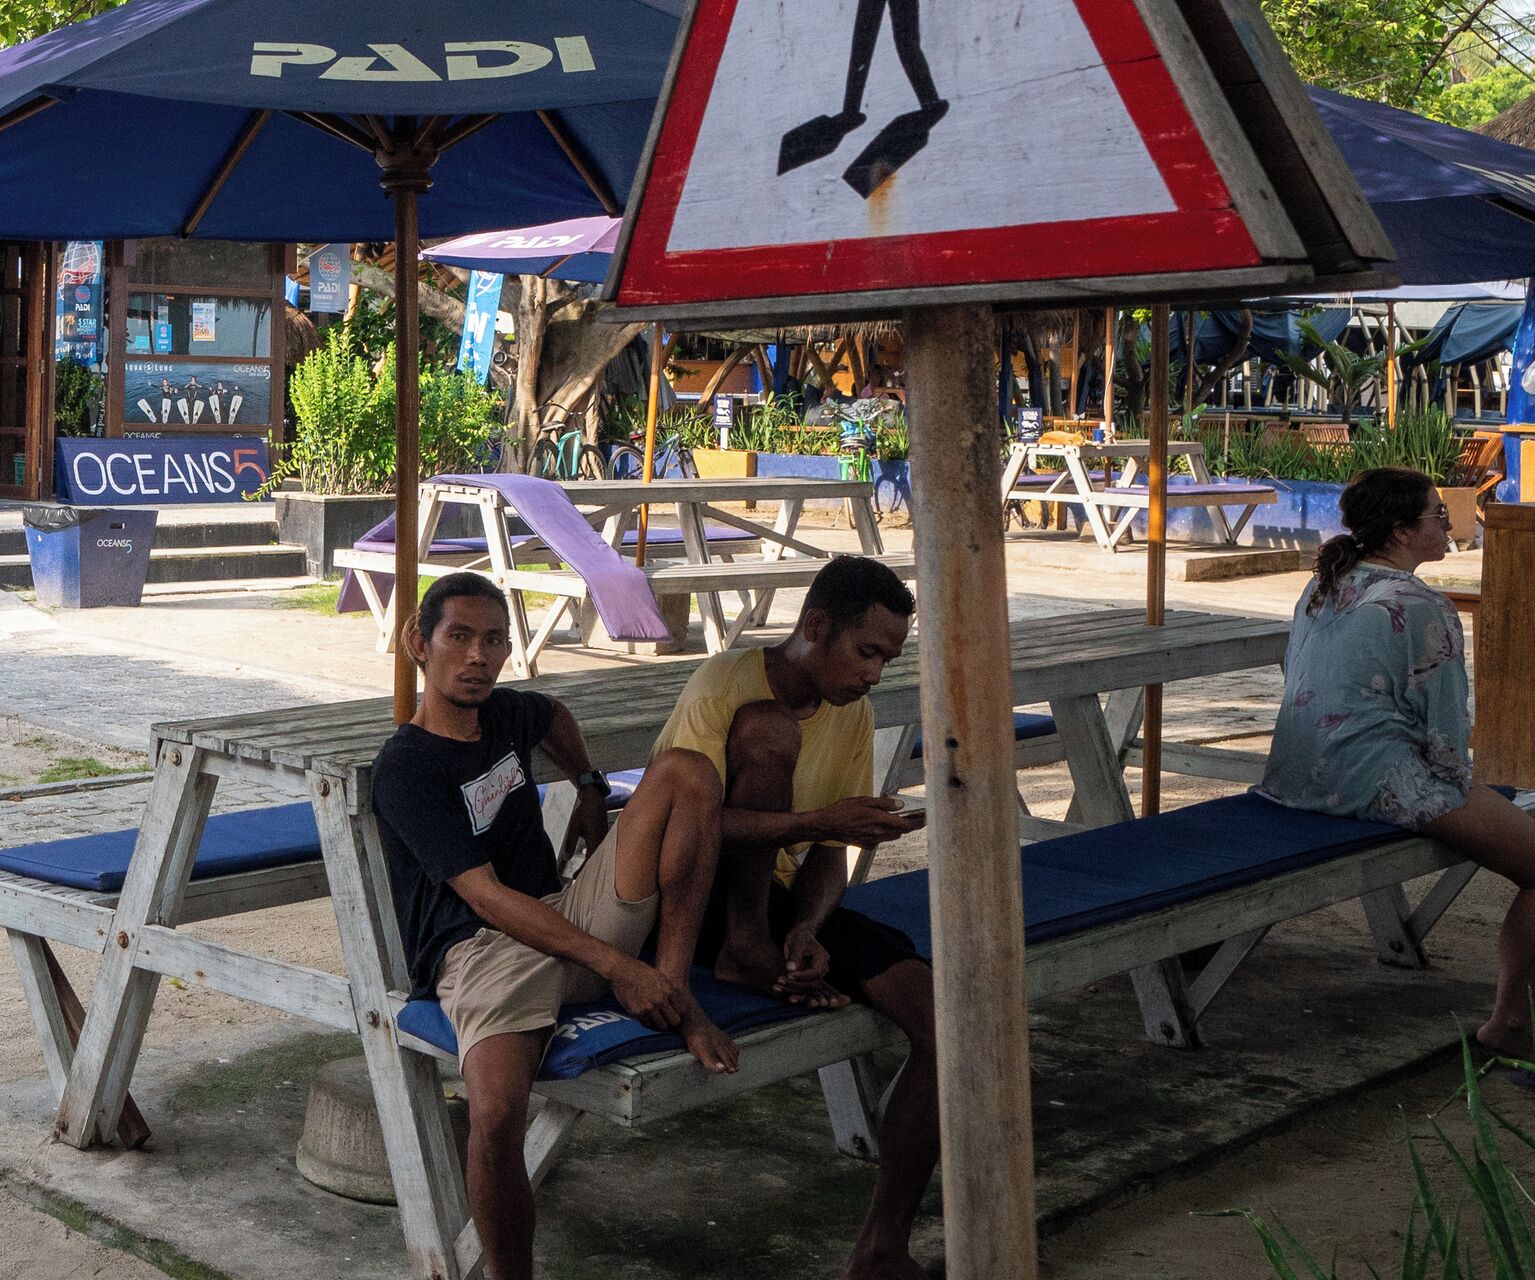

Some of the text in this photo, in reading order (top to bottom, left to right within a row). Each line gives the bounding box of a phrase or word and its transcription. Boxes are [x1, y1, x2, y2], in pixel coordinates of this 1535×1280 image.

[250, 35, 596, 82] PADI
[489, 233, 585, 249] PADI
[318, 281, 341, 293] PADI
[75, 303, 91, 312] PADI
[234, 364, 271, 380] OCEANS5
[73, 448, 267, 501] OCEANS5
[96, 538, 133, 554] OCEANS5
